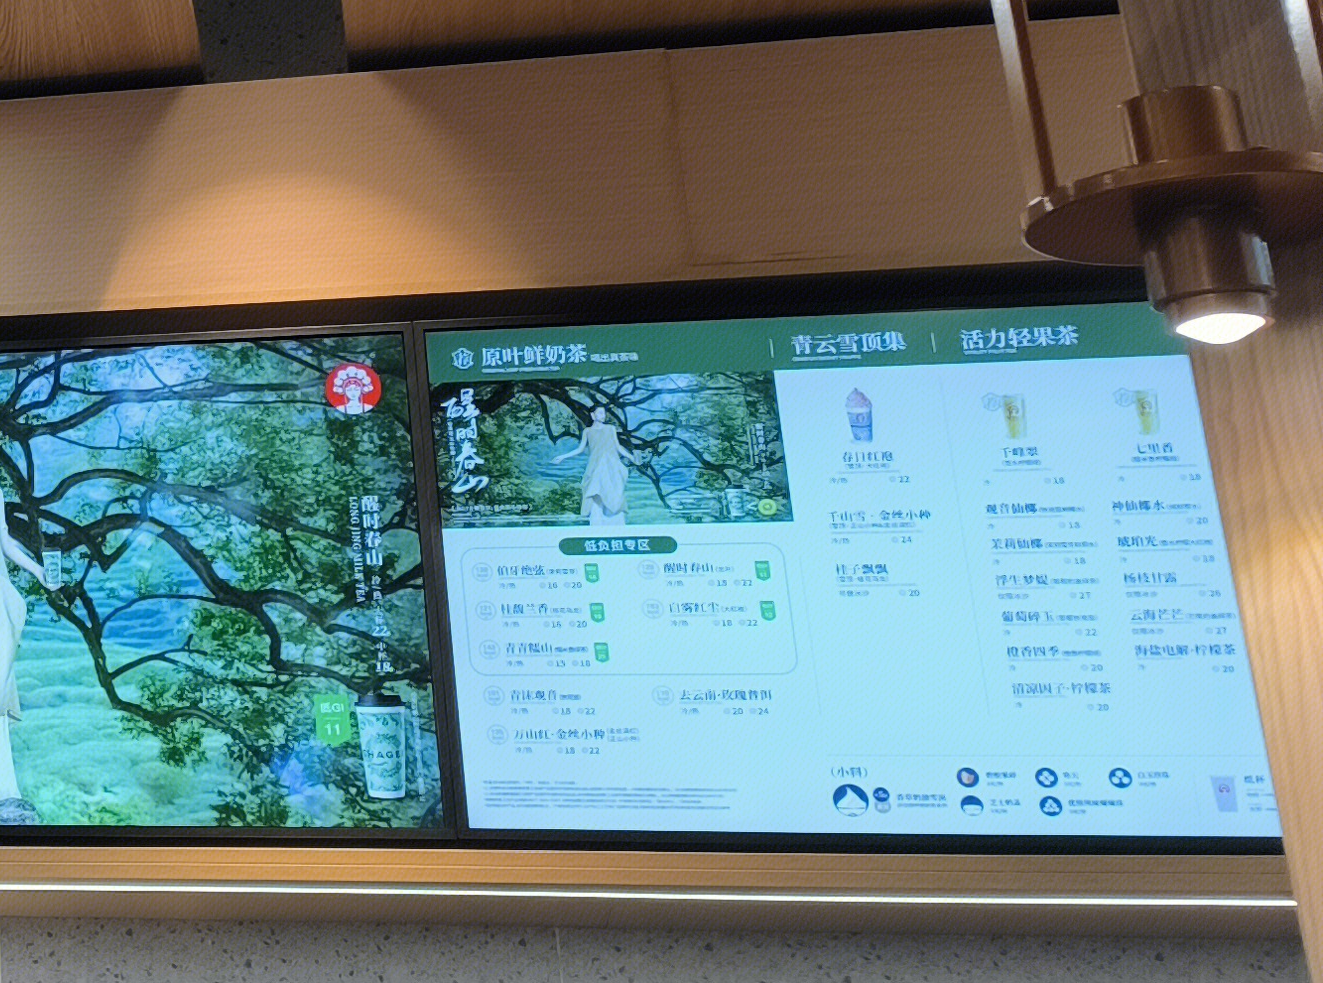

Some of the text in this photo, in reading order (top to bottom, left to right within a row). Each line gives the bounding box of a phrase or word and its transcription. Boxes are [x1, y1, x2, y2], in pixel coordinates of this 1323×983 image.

[961, 325, 1080, 351] 活力轻果茶
[481, 343, 588, 367] 原叶鲜奶茶
[349, 496, 360, 524] LONG
[360, 495, 383, 566] 醒时春山
[584, 538, 651, 552] 低负担专区
[324, 723, 341, 736] 11
